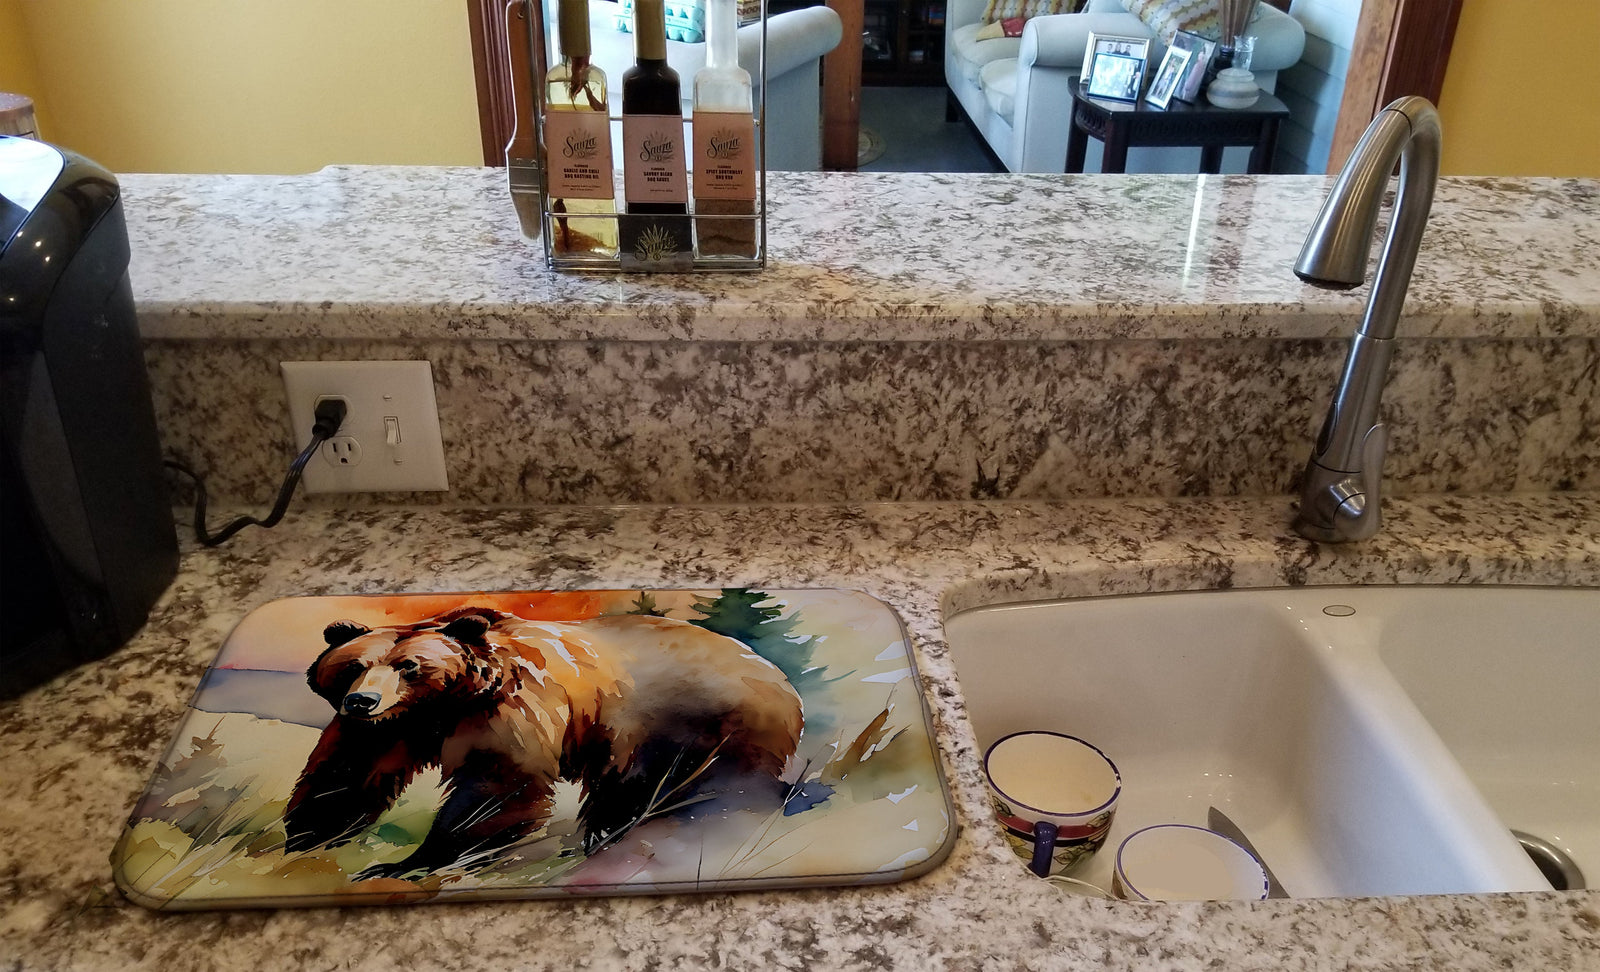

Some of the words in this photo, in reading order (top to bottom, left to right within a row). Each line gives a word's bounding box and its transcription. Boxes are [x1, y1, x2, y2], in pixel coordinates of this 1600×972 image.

[562, 135, 598, 158] Sauza
[639, 140, 675, 161] Sauza
[706, 136, 740, 158] Sauza
